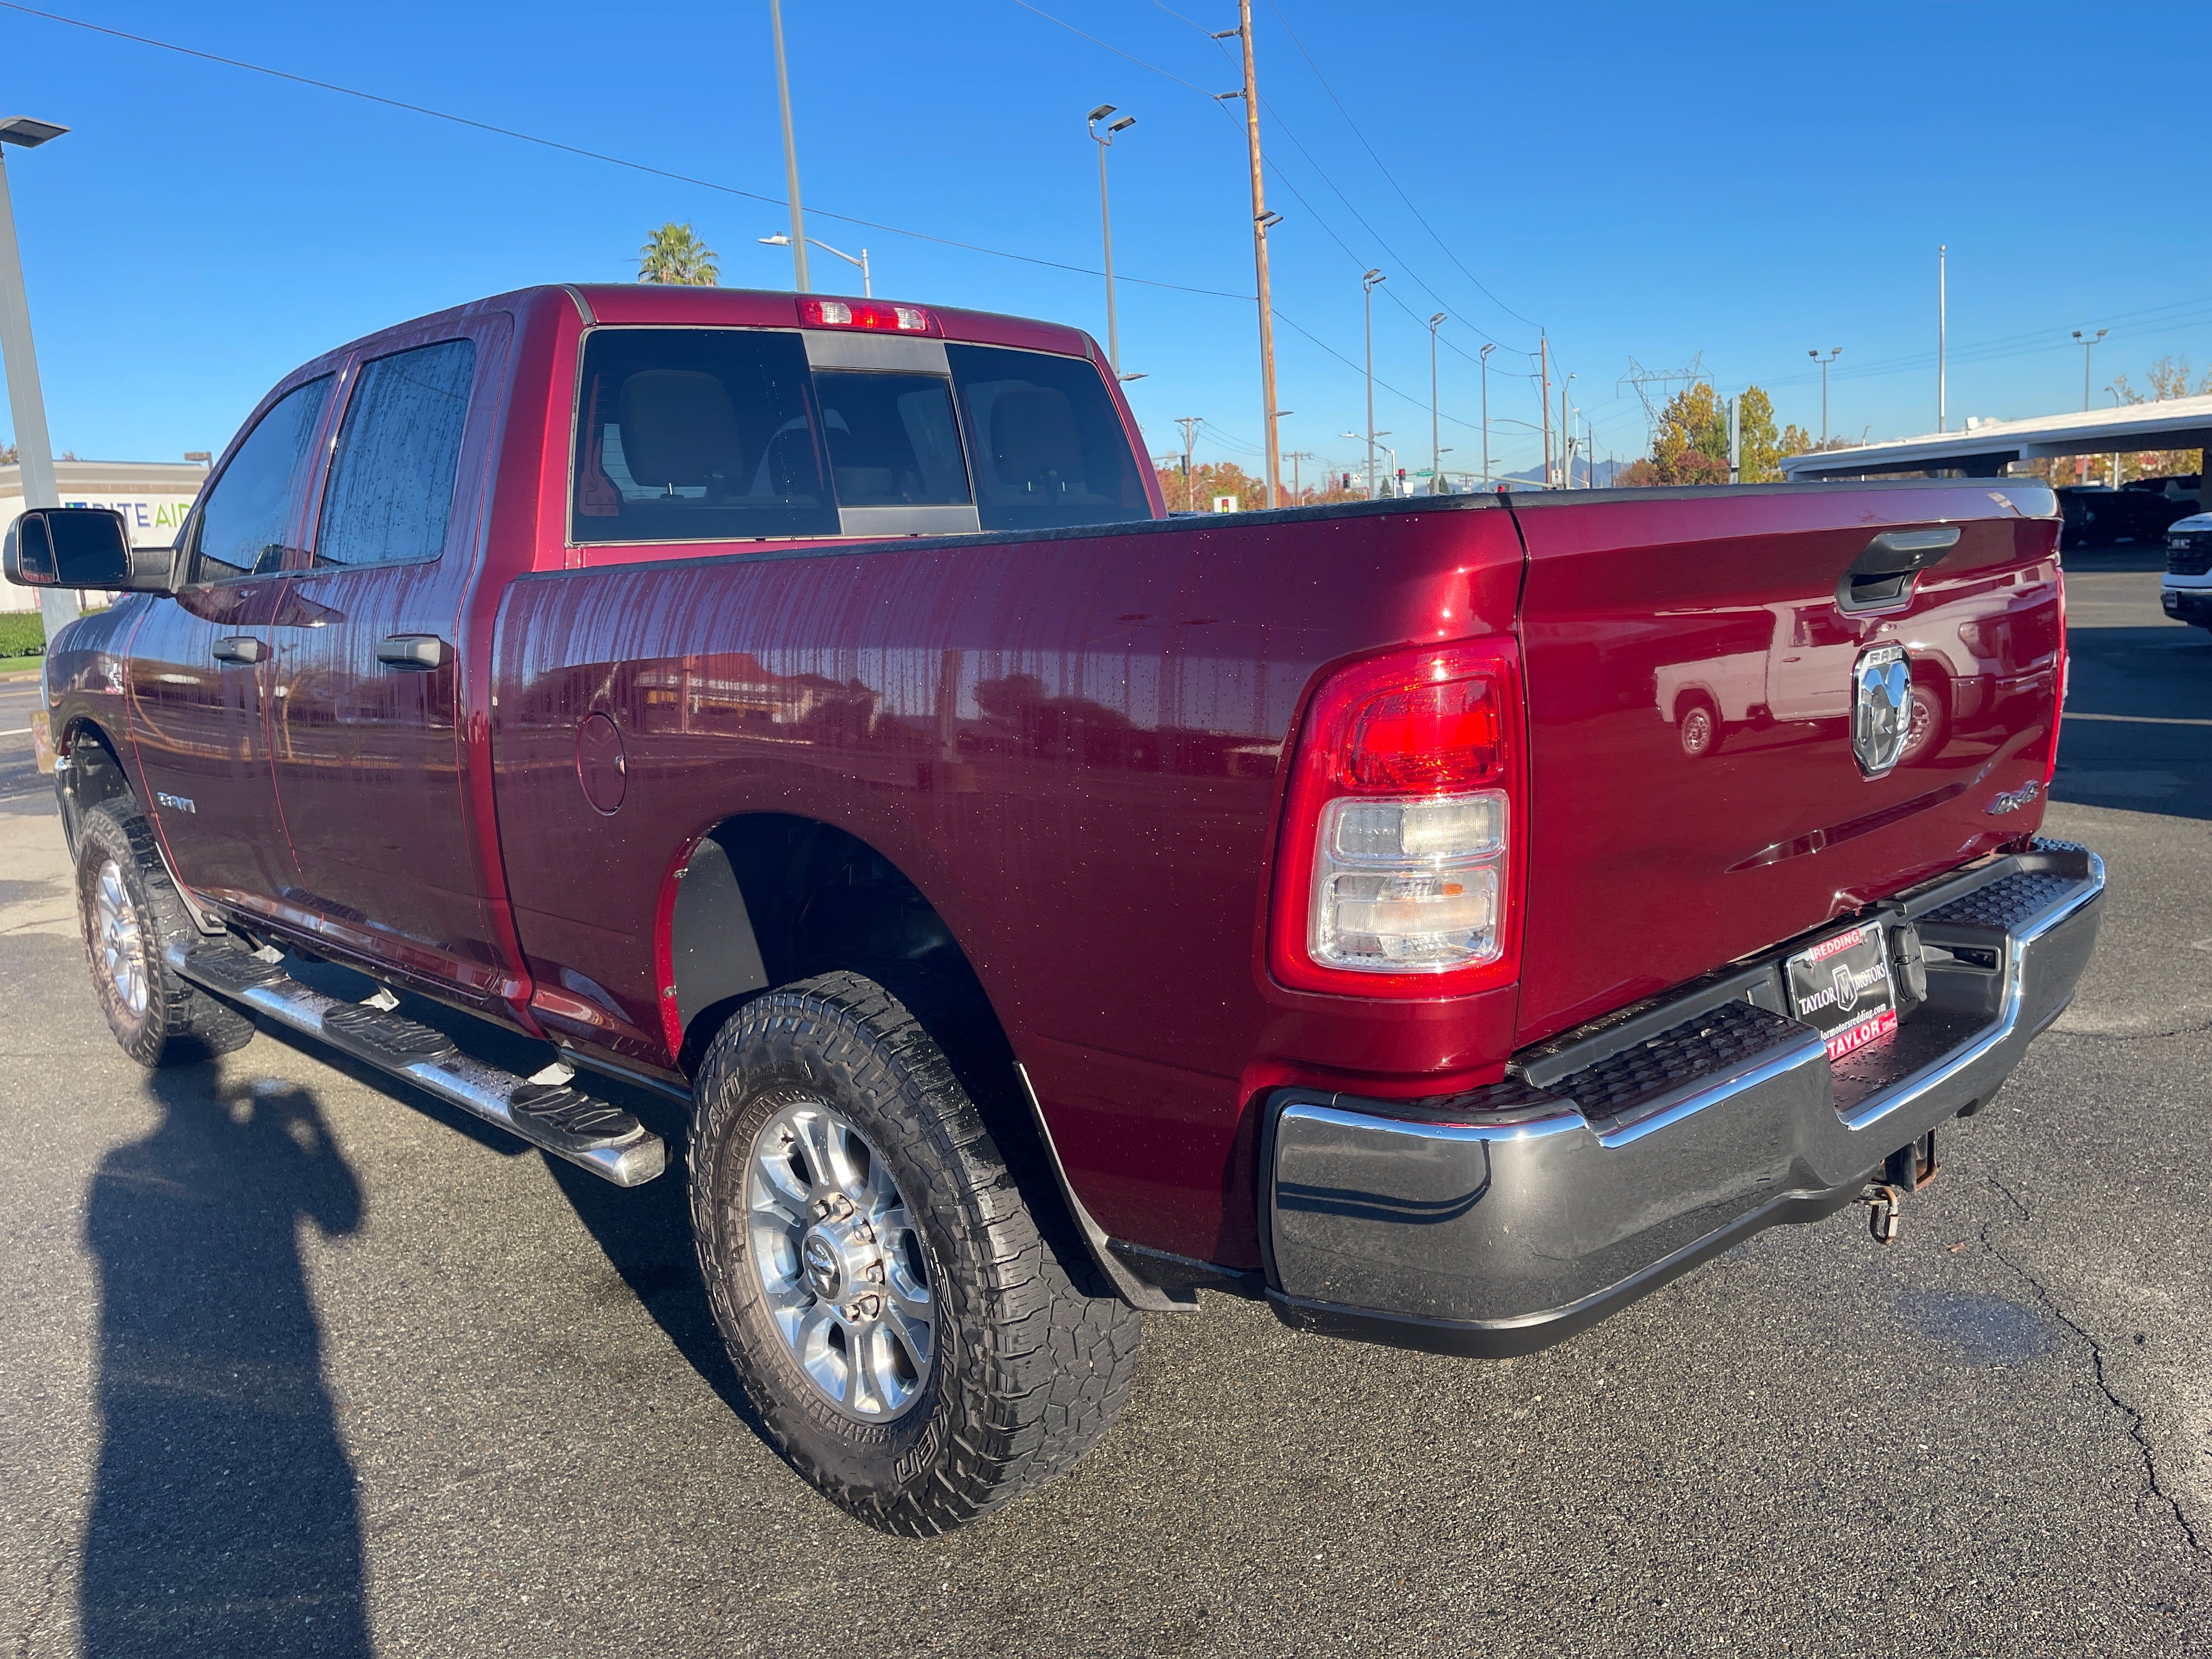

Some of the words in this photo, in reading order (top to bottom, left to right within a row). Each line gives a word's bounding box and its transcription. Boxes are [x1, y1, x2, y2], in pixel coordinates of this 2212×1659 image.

[92, 503, 150, 527] TE
[1870, 648, 1903, 663] RAM
[1813, 932, 1859, 960] REDDING
[1799, 987, 1837, 1014] TAYLOR
[1853, 962, 1886, 990] MOTORS
[1820, 1003, 1886, 1040] lormotorsredding.com
[1882, 1017, 1897, 1031] GMC
[1827, 1022, 1880, 1058] TAYLOR
